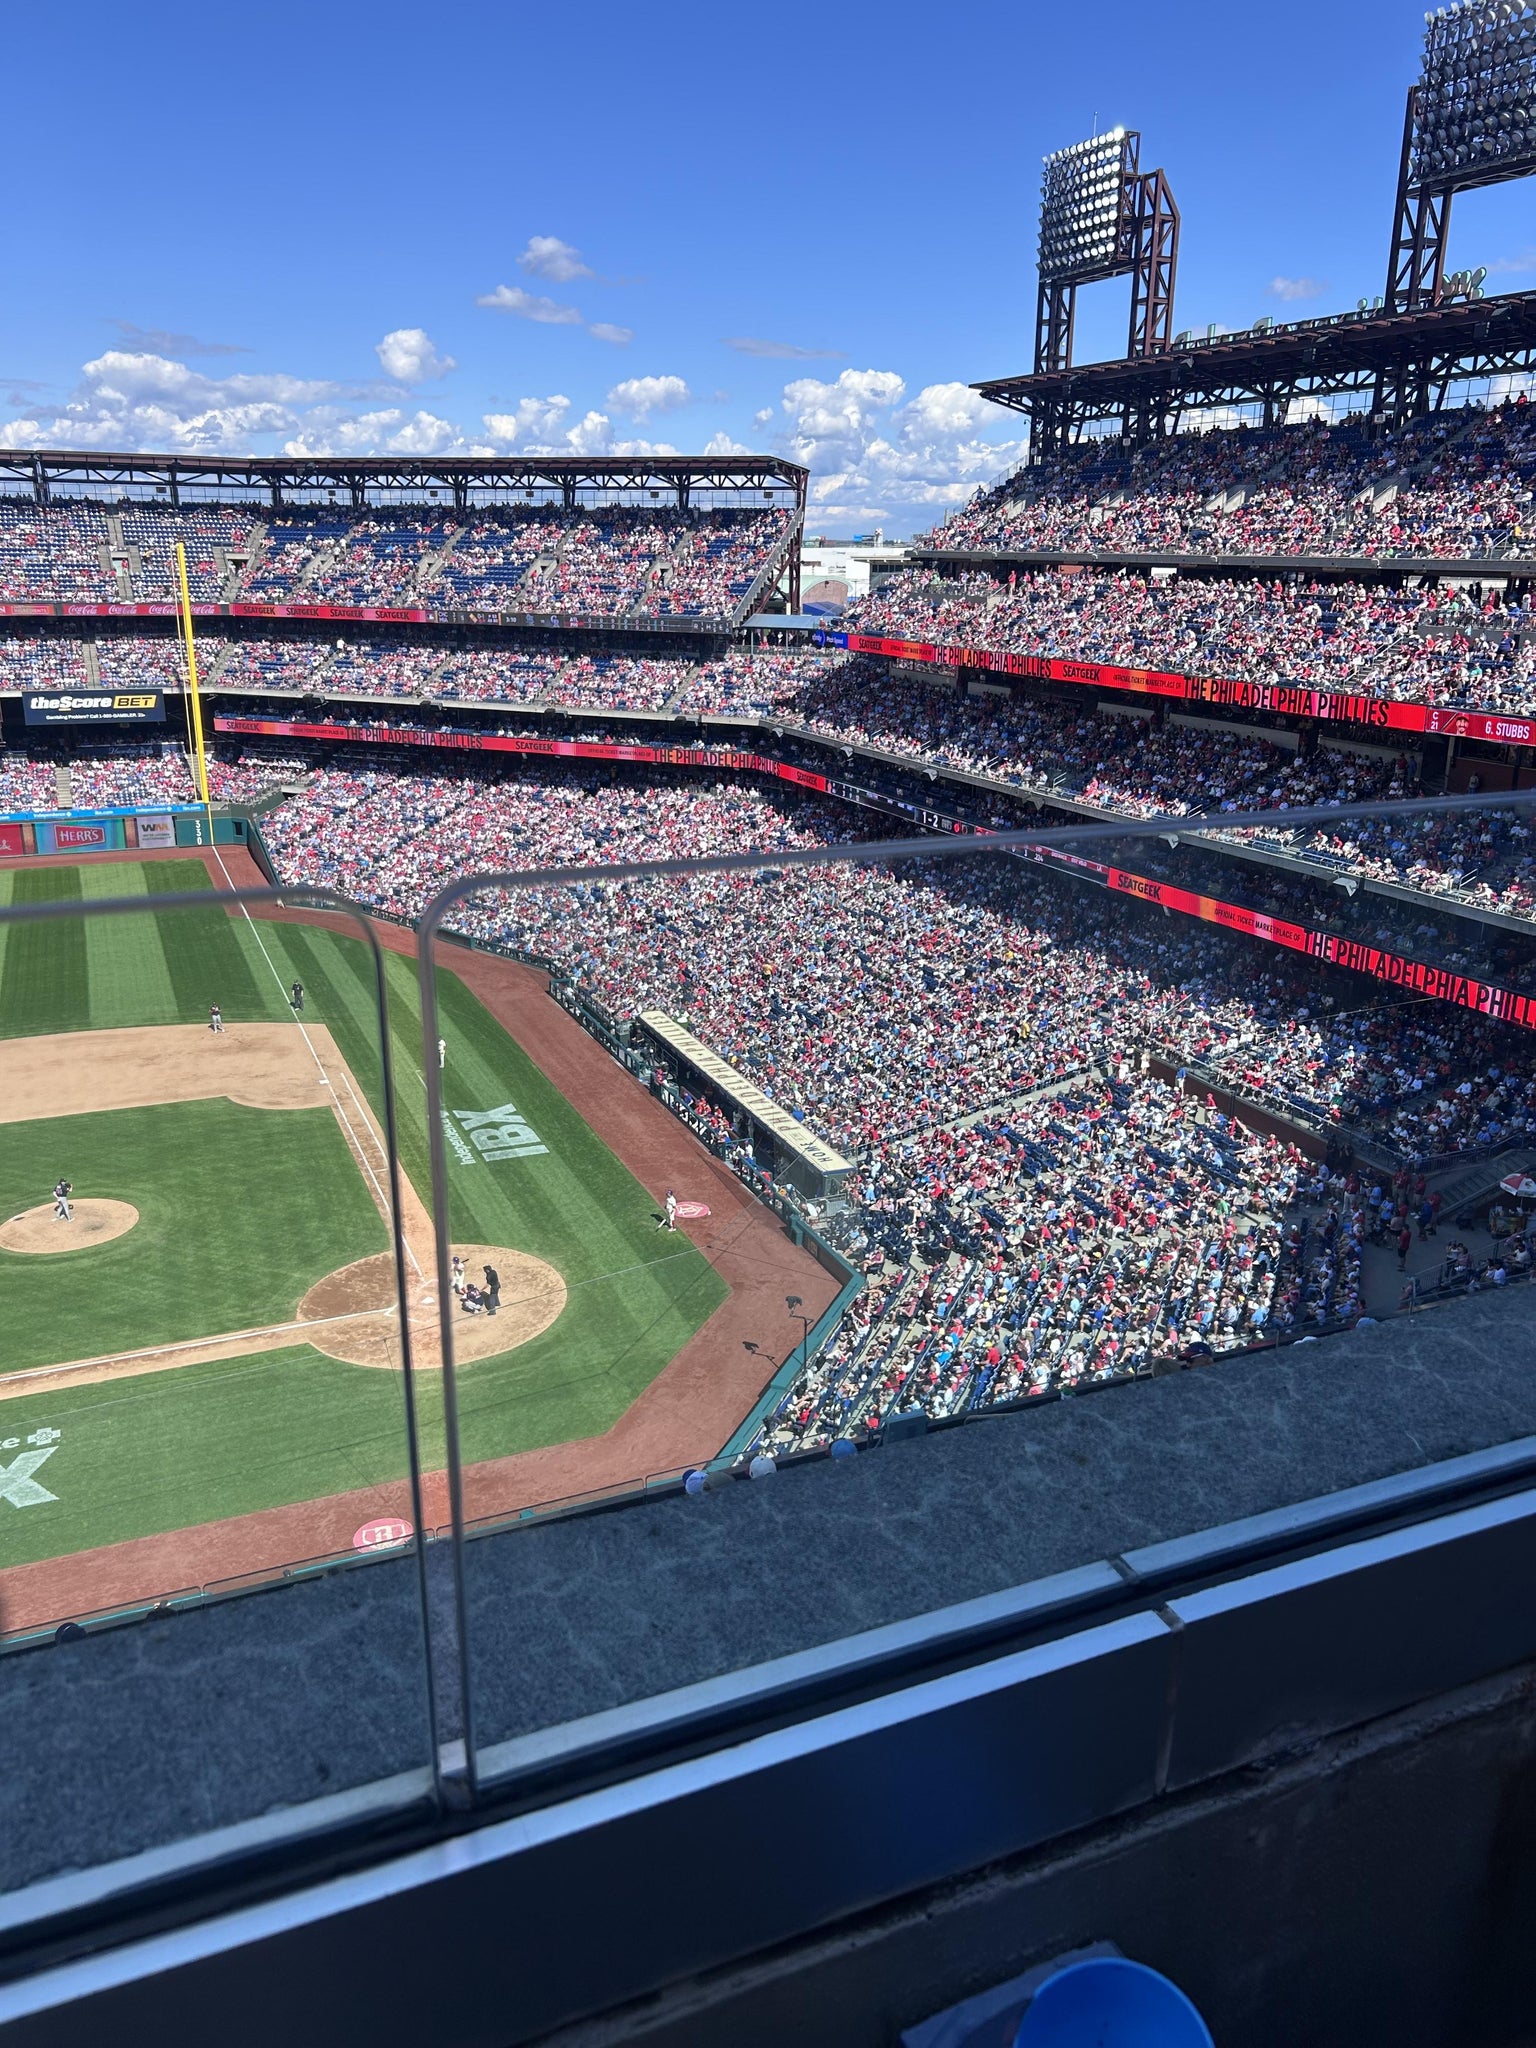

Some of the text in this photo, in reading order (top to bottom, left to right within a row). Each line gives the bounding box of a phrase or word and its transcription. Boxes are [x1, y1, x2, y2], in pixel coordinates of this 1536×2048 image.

[68, 604, 97, 615] Coca-Cola
[108, 604, 137, 614] Coca-Cola
[148, 604, 177, 614] Coca-Cola
[243, 605, 276, 615] SEATGEEK
[286, 607, 319, 616] SEATGEEK
[330, 608, 364, 618] SEATGEEK
[375, 610, 409, 620] SEATGEEK
[858, 638, 883, 651] SEATGEEK
[933, 645, 1051, 678] THE PHILADELPHIA PHILLIES
[1062, 664, 1100, 682] SEATGEEK
[31, 695, 152, 711] theScore BET
[1184, 676, 1389, 726] THE PHILADELPHIA PHILLIES
[1432, 711, 1439, 720] C
[226, 720, 260, 732] SEATGEEK
[1430, 722, 1438, 730] 21
[1485, 721, 1530, 740] G. STUBBS
[346, 728, 483, 748] THE PHILADELPHIA PHILLIES
[515, 741, 553, 752] SEATGEEK
[654, 749, 781, 776] THE PHILADELPHIA PHILLIES
[796, 771, 818, 786] SEATGEEK
[922, 811, 938, 828] 1-2
[60, 829, 99, 842] HERR'S
[195, 820, 203, 845] 330
[1118, 873, 1161, 900] SEATGEEK
[1214, 908, 1301, 942] OFFICIAL TICKET MARKETPLACE OF
[1304, 928, 1536, 1029] THE PHILADELPHIA PHILL
[645, 1015, 705, 1052] PHILLIES
[698, 1056, 801, 1132] PHILADELPHIA
[452, 1103, 550, 1162] IBX
[800, 1141, 833, 1163] HOME
